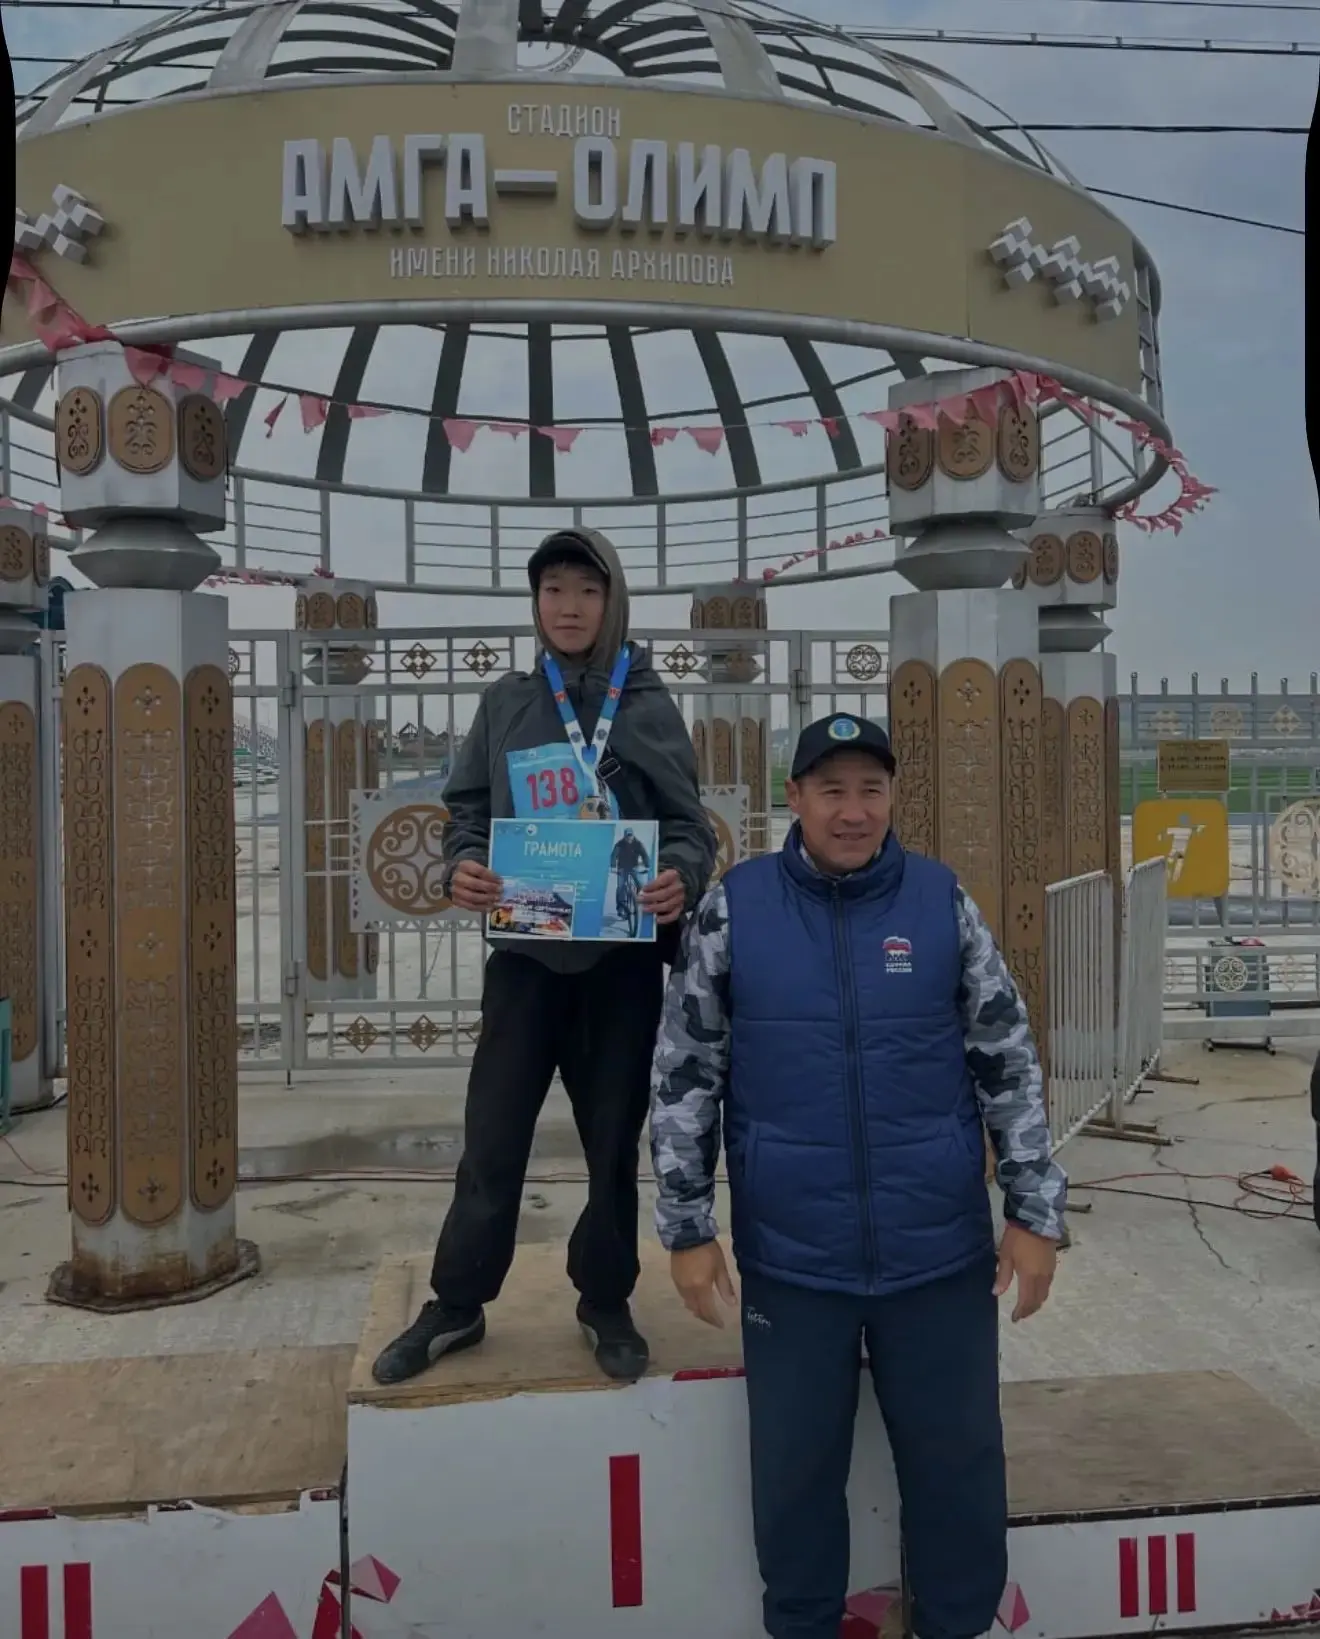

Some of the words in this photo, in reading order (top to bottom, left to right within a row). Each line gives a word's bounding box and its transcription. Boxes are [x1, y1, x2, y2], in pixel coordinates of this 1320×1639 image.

[507, 104, 621, 138] СТАДИОН
[389, 247, 476, 278] ИМЕНИ
[487, 248, 600, 278] НИКОЛАЯ
[611, 250, 735, 285] АРХИПОВА
[527, 767, 579, 811] 138
[523, 840, 583, 858] ГРАМОТА
